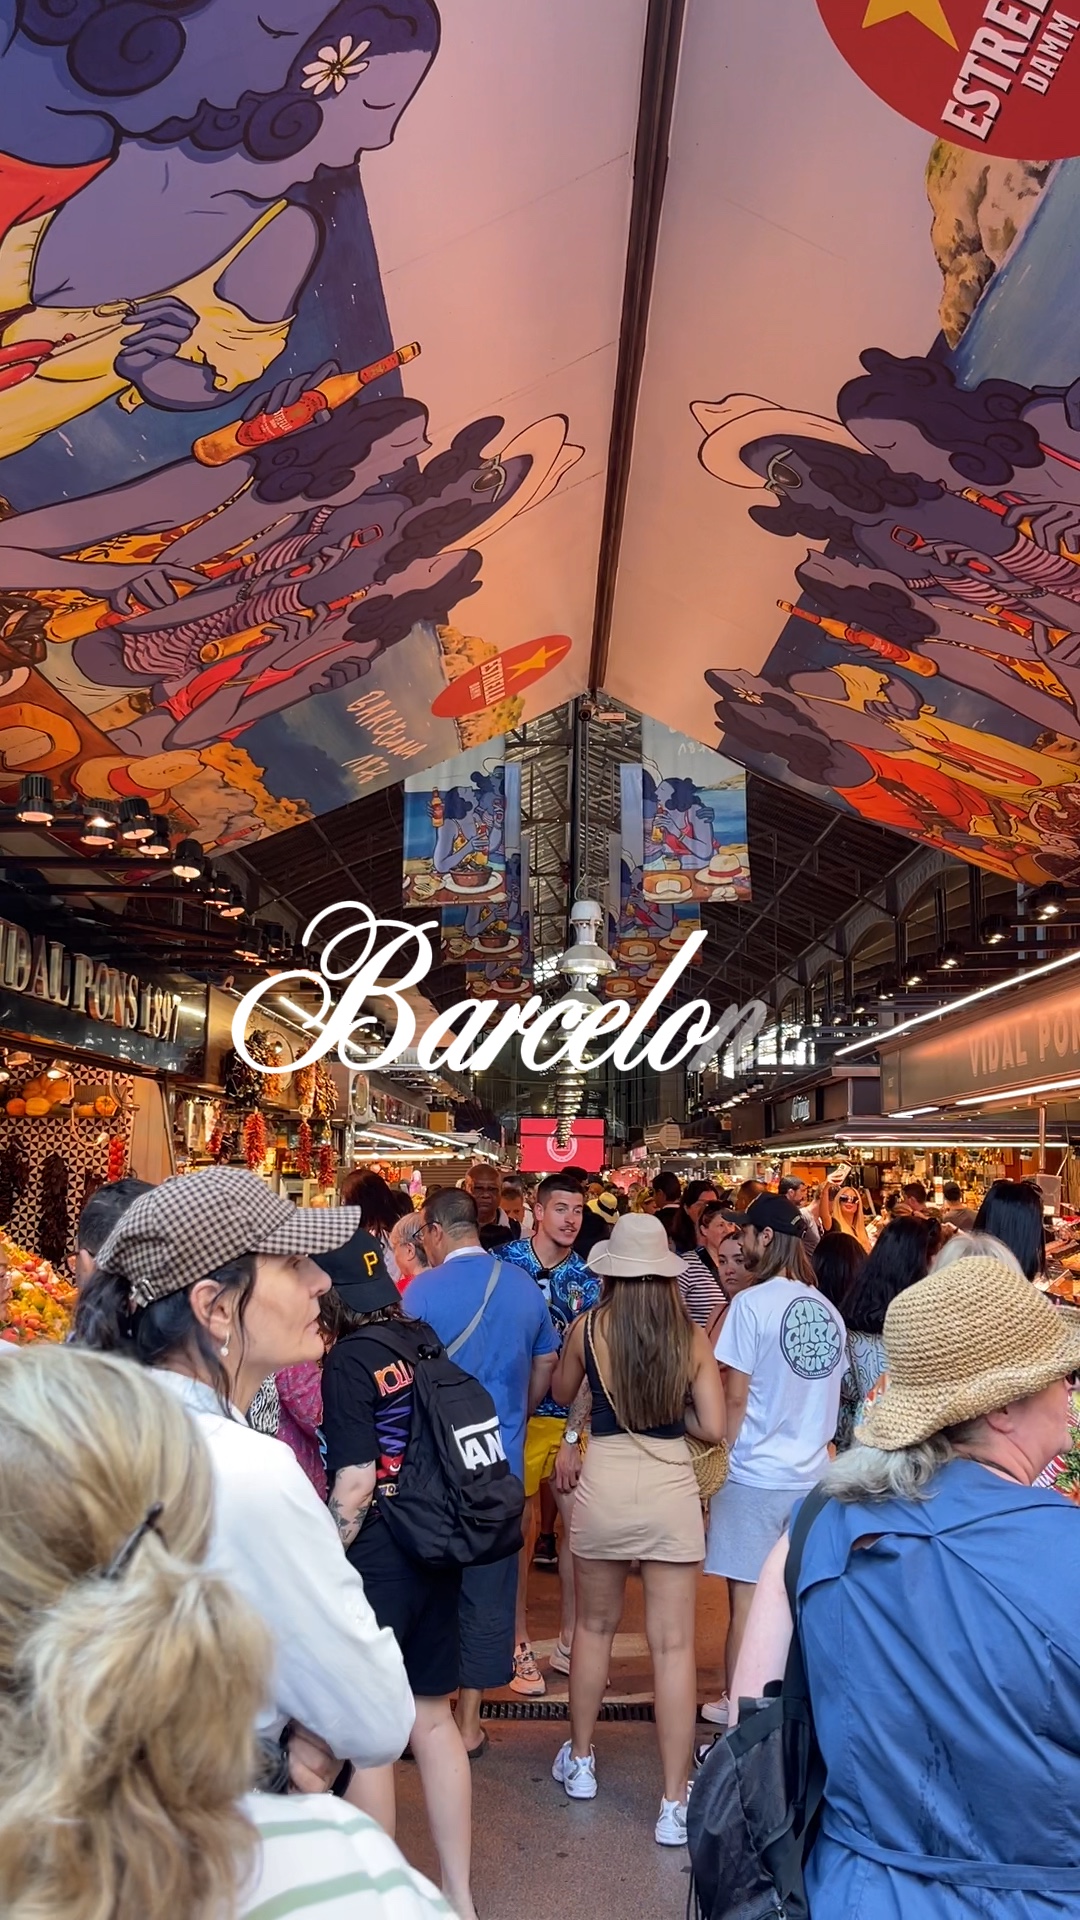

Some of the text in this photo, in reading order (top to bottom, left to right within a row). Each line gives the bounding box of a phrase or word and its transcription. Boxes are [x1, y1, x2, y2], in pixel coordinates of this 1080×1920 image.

[1021, 10, 1080, 95] DAMM
[480, 656, 506, 705] ESTRELLA
[346, 690, 428, 760] BARCELONA
[71, 952, 139, 1029] PONS
[968, 1023, 1028, 1077] VIDAL
[363, 1251, 378, 1276] P
[785, 1321, 840, 1349] CURL
[786, 1300, 831, 1329] RIP
[788, 1342, 830, 1361] WET
